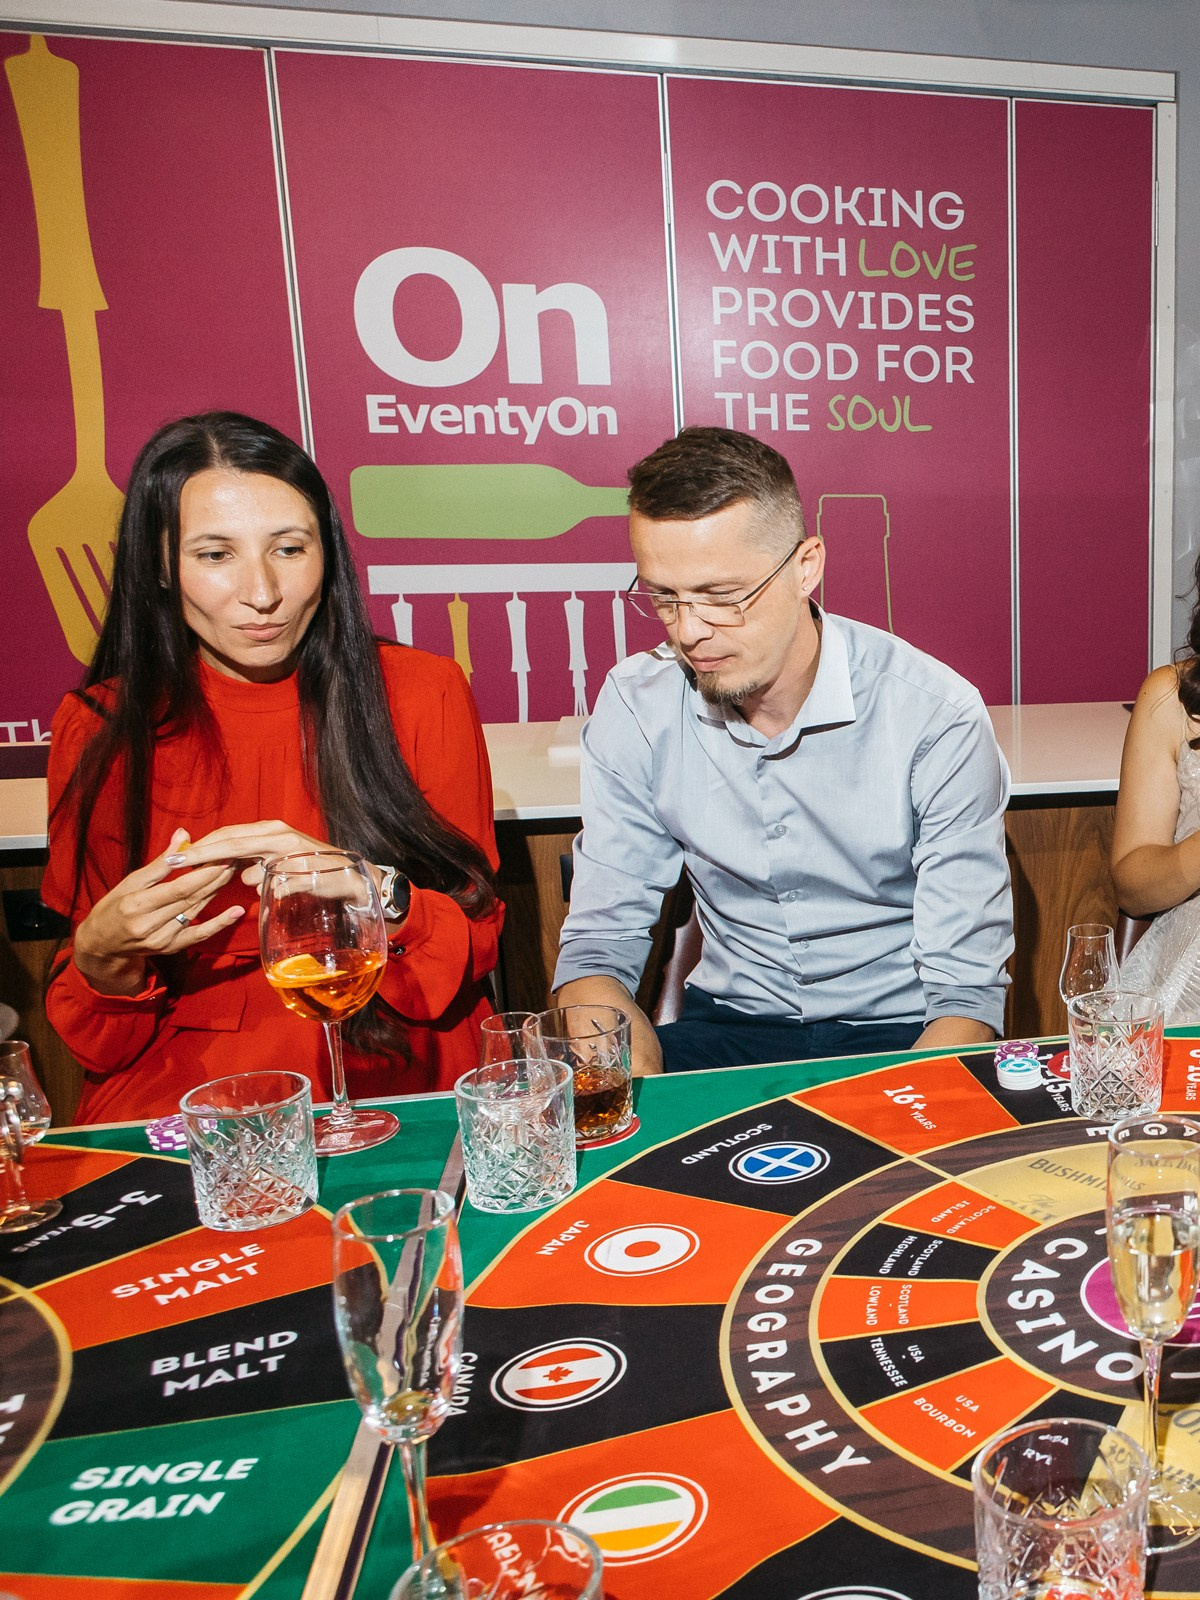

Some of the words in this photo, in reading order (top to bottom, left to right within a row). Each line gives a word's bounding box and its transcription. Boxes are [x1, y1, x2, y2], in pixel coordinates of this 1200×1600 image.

[706, 179, 965, 230] COOKING
[708, 232, 847, 277] WITH
[858, 238, 978, 281] LOVE
[353, 246, 611, 388] On
[712, 286, 975, 333] PROVIDES
[713, 340, 859, 381] FOOD
[877, 344, 975, 383] FOR
[366, 395, 618, 445] EventyOn
[714, 392, 810, 431] THE
[827, 394, 933, 432] SOUL
[883, 1085, 927, 1111] 16+
[909, 1110, 937, 1131] YEARS
[1051, 1092, 1072, 1112] YEARS
[1186, 1081, 1196, 1100] YEARS
[681, 1123, 773, 1165] SCOTLAND
[931, 1200, 971, 1223] ISLAND
[946, 1204, 996, 1234] SCOTLAND
[535, 1220, 590, 1255] JAPAN
[878, 1235, 918, 1274] HIGHLAND
[907, 1239, 943, 1276] SCOTLAND
[111, 1243, 266, 1299] SINGLE
[154, 1262, 261, 1305] MALT
[866, 1285, 882, 1326] LOWLAND
[897, 1284, 912, 1325] SCOTLAND
[1008, 1237, 1146, 1381] CASINO
[151, 1331, 299, 1376] BLEND
[746, 1238, 871, 1474] GEOGRAPHY
[870, 1337, 908, 1387] TENNESSEE
[907, 1344, 925, 1363] USA
[162, 1354, 287, 1397] MALT
[447, 1352, 479, 1417] CANADA
[913, 1397, 976, 1438] BOURBON
[955, 1395, 980, 1413] USA
[70, 1457, 259, 1491] SINGLE
[49, 1490, 226, 1526] GRAIN
